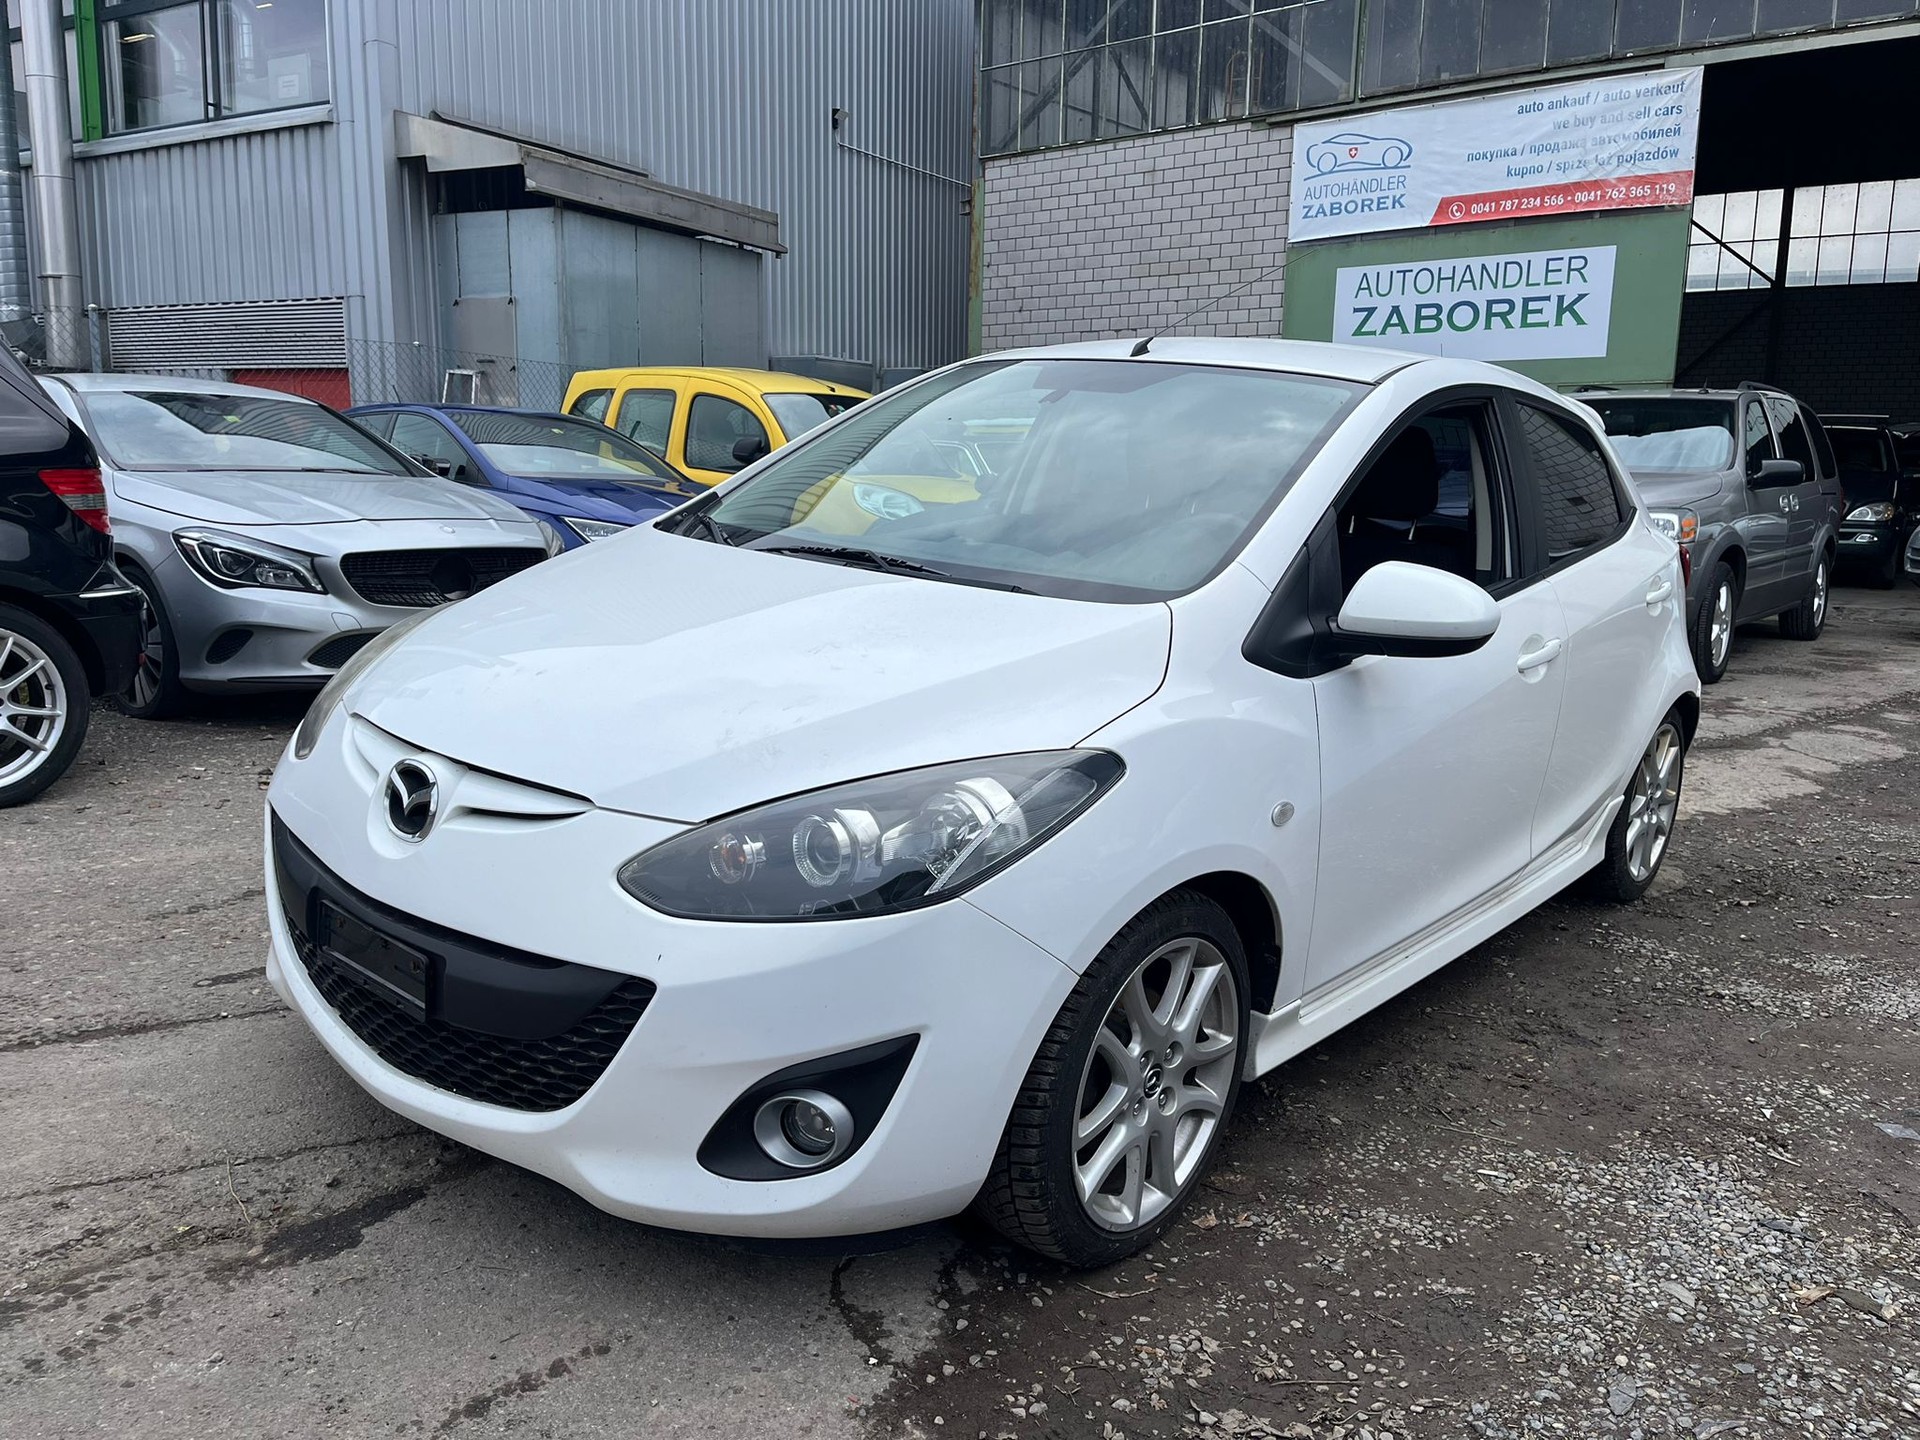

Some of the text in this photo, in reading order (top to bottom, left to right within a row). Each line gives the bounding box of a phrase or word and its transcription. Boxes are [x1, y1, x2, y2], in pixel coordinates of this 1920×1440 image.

[1517, 101, 1544, 115] auto
[1547, 91, 1592, 111] ankauf
[1603, 89, 1631, 103] auto
[1635, 80, 1686, 98] verkauf
[1553, 104, 1683, 131] we buy and sell cars
[1467, 147, 1517, 162] покупка
[1506, 164, 1544, 178] kupno
[1616, 146, 1680, 168] pojazdów
[1303, 174, 1407, 201] AUTOHÄNDLER
[1471, 182, 1676, 214] 0041 787 234 566 0041 762 365 119
[1301, 193, 1406, 220] ZABOREK
[1354, 255, 1589, 299] AUTOHANDLER
[1351, 292, 1591, 337] ZABOREK
